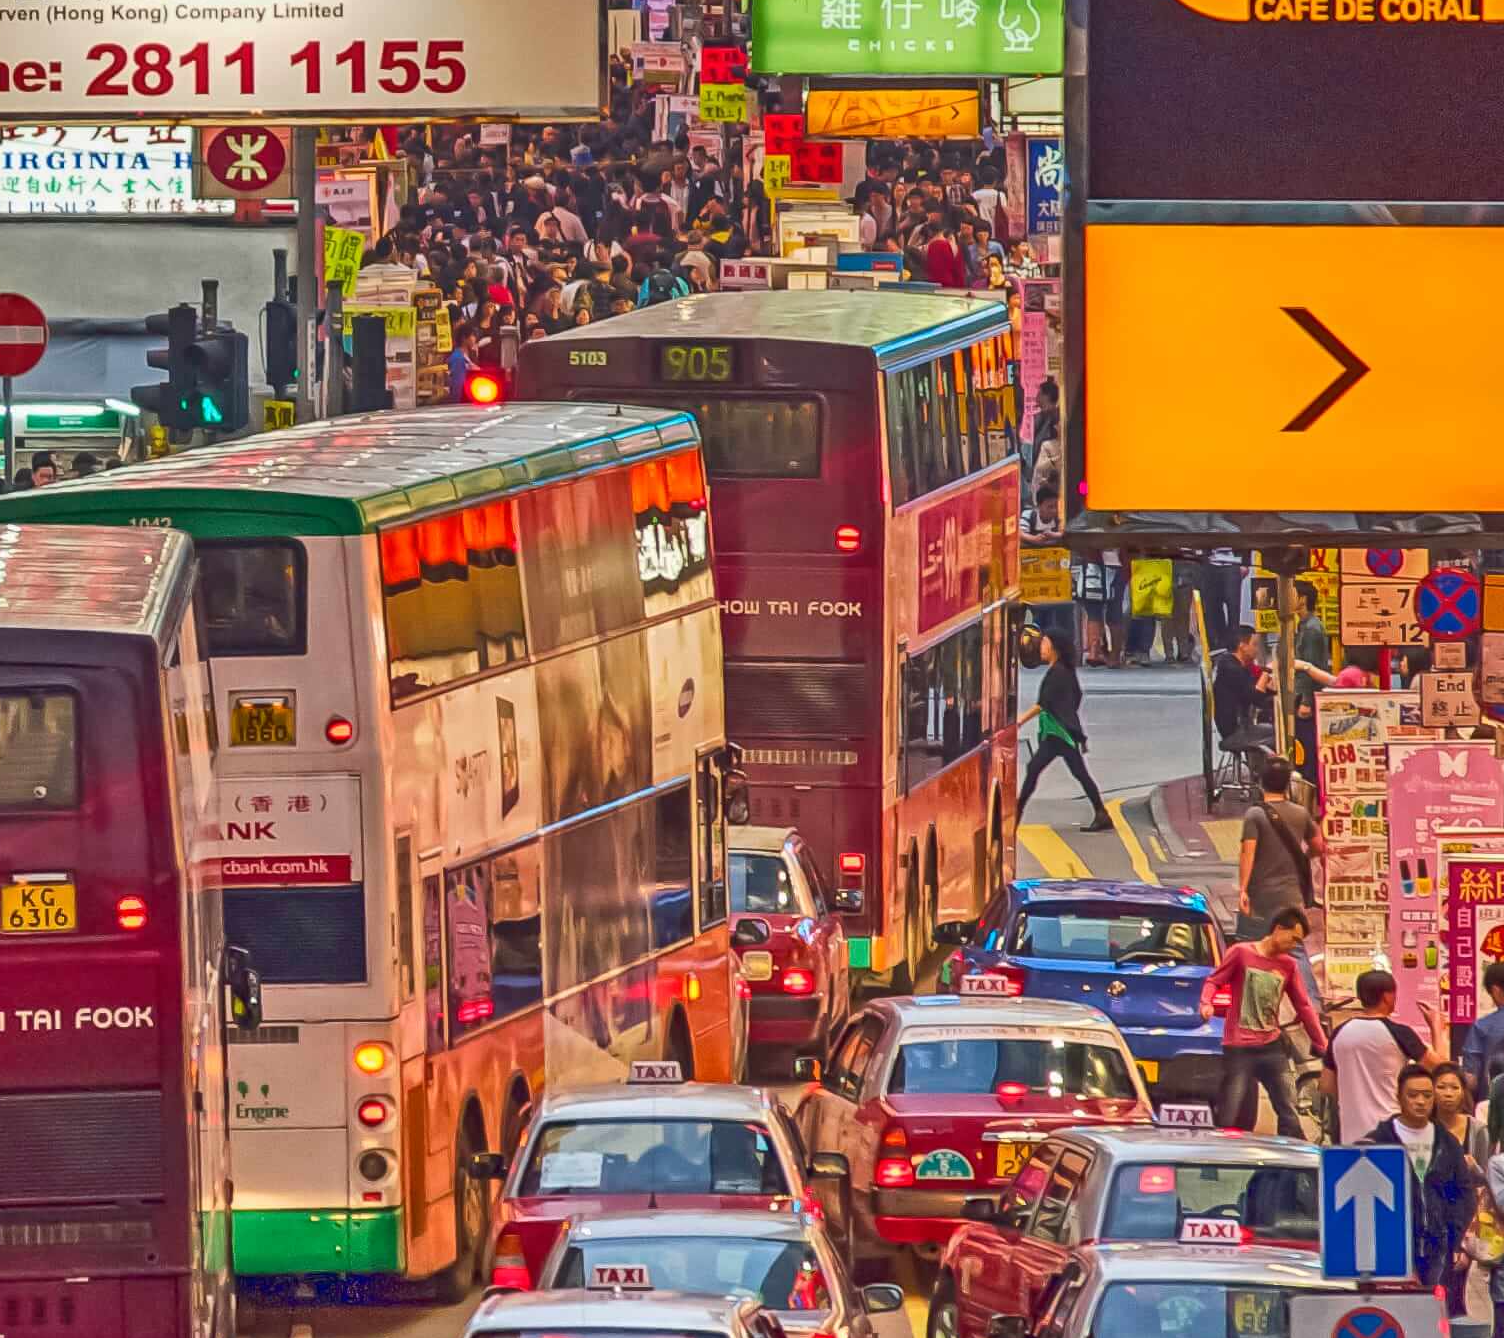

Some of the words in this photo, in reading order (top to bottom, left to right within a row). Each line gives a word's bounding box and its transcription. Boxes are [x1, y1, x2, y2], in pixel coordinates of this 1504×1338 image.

[45, 4, 106, 24] (Hong
[111, 3, 169, 24] Kong)
[175, 3, 268, 24] Company
[272, 3, 344, 22] Limited
[85, 42, 258, 97] 2811
[290, 39, 466, 95] 1155
[662, 347, 731, 380] 905
[807, 600, 862, 617] FOOK
[1396, 589, 1410, 609] 7
[1436, 679, 1466, 693] End
[21, 888, 57, 908] KG
[8, 907, 70, 928] 6316
[965, 979, 1008, 993] TAXI
[15, 1009, 62, 1032] TAI
[74, 1005, 155, 1030] FOOK
[633, 1063, 678, 1080] TAXI
[236, 1102, 290, 1124] Engine
[1164, 1108, 1211, 1125] TAXI
[1186, 1222, 1237, 1239] TAXI
[595, 1265, 649, 1286] TAXI
